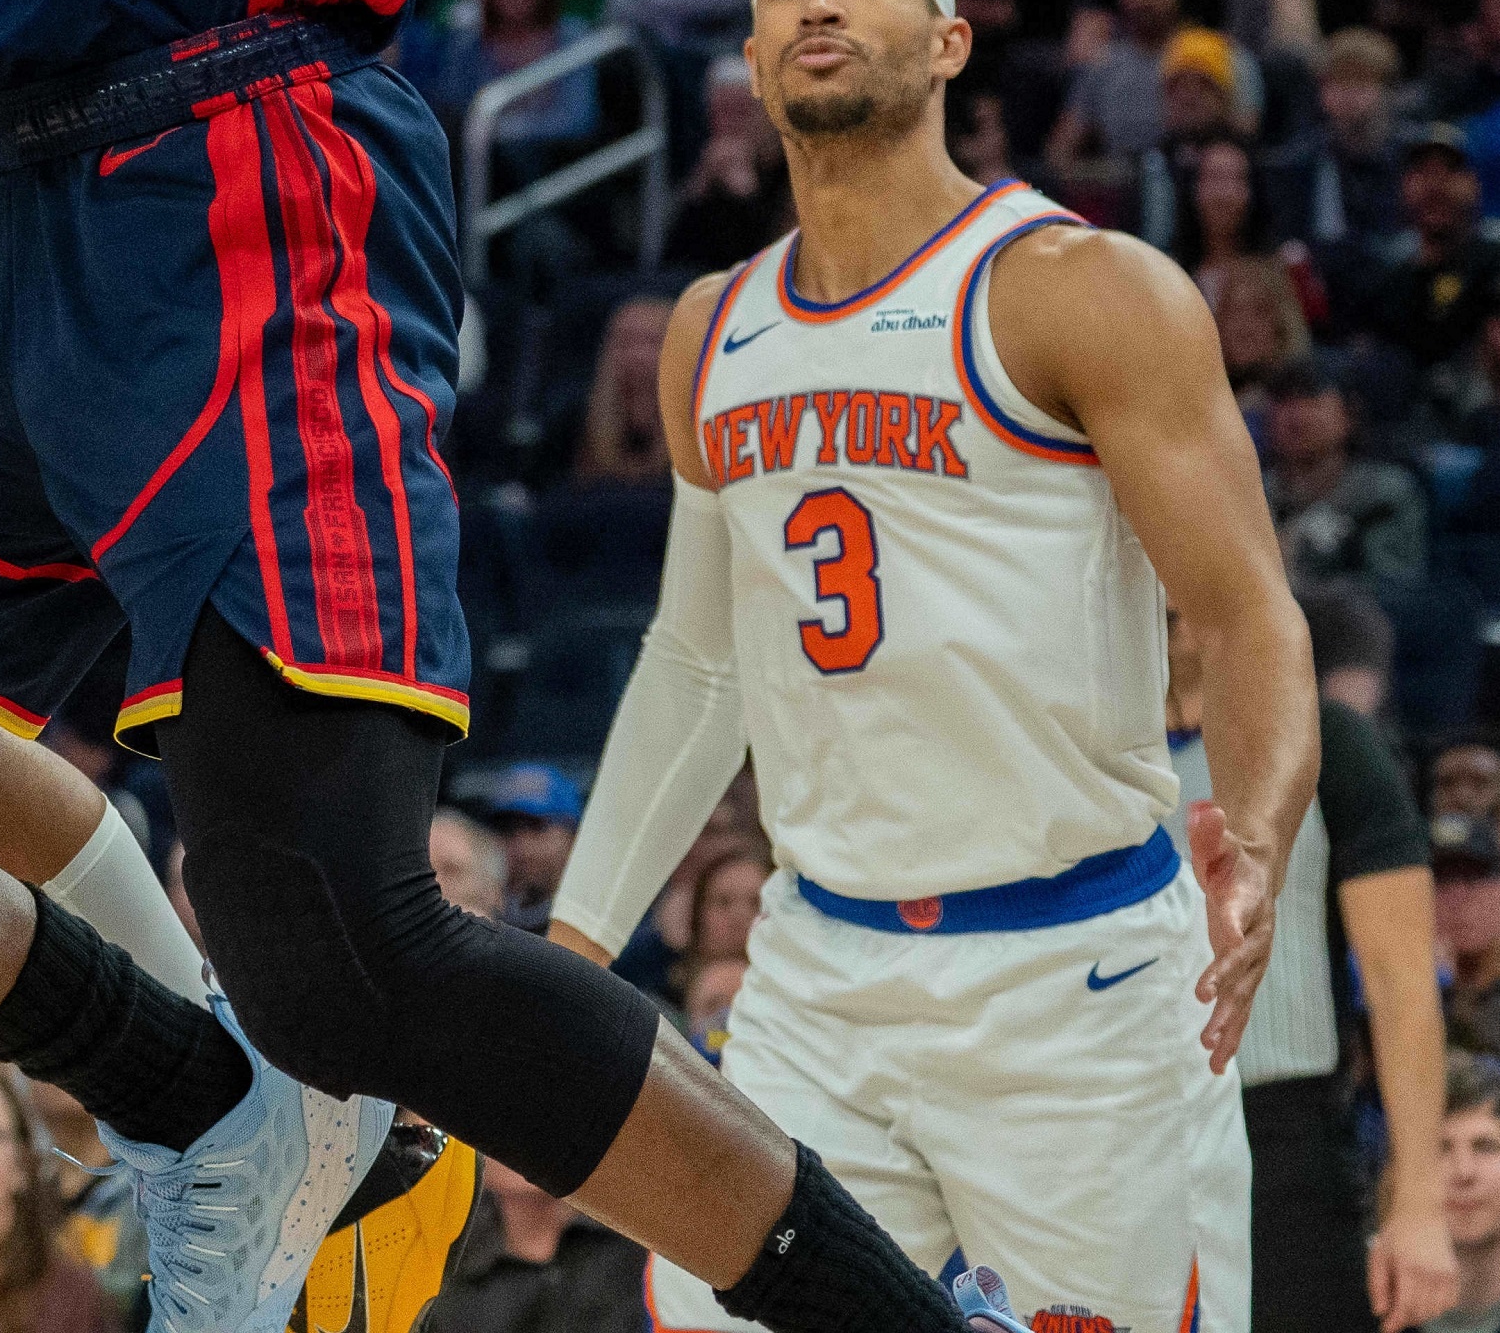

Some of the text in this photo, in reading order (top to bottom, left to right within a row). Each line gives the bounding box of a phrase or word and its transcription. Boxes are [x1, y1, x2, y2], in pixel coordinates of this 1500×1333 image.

[702, 388, 970, 488] NEW YORK
[783, 485, 886, 677] 3
[778, 1229, 797, 1255] alo
